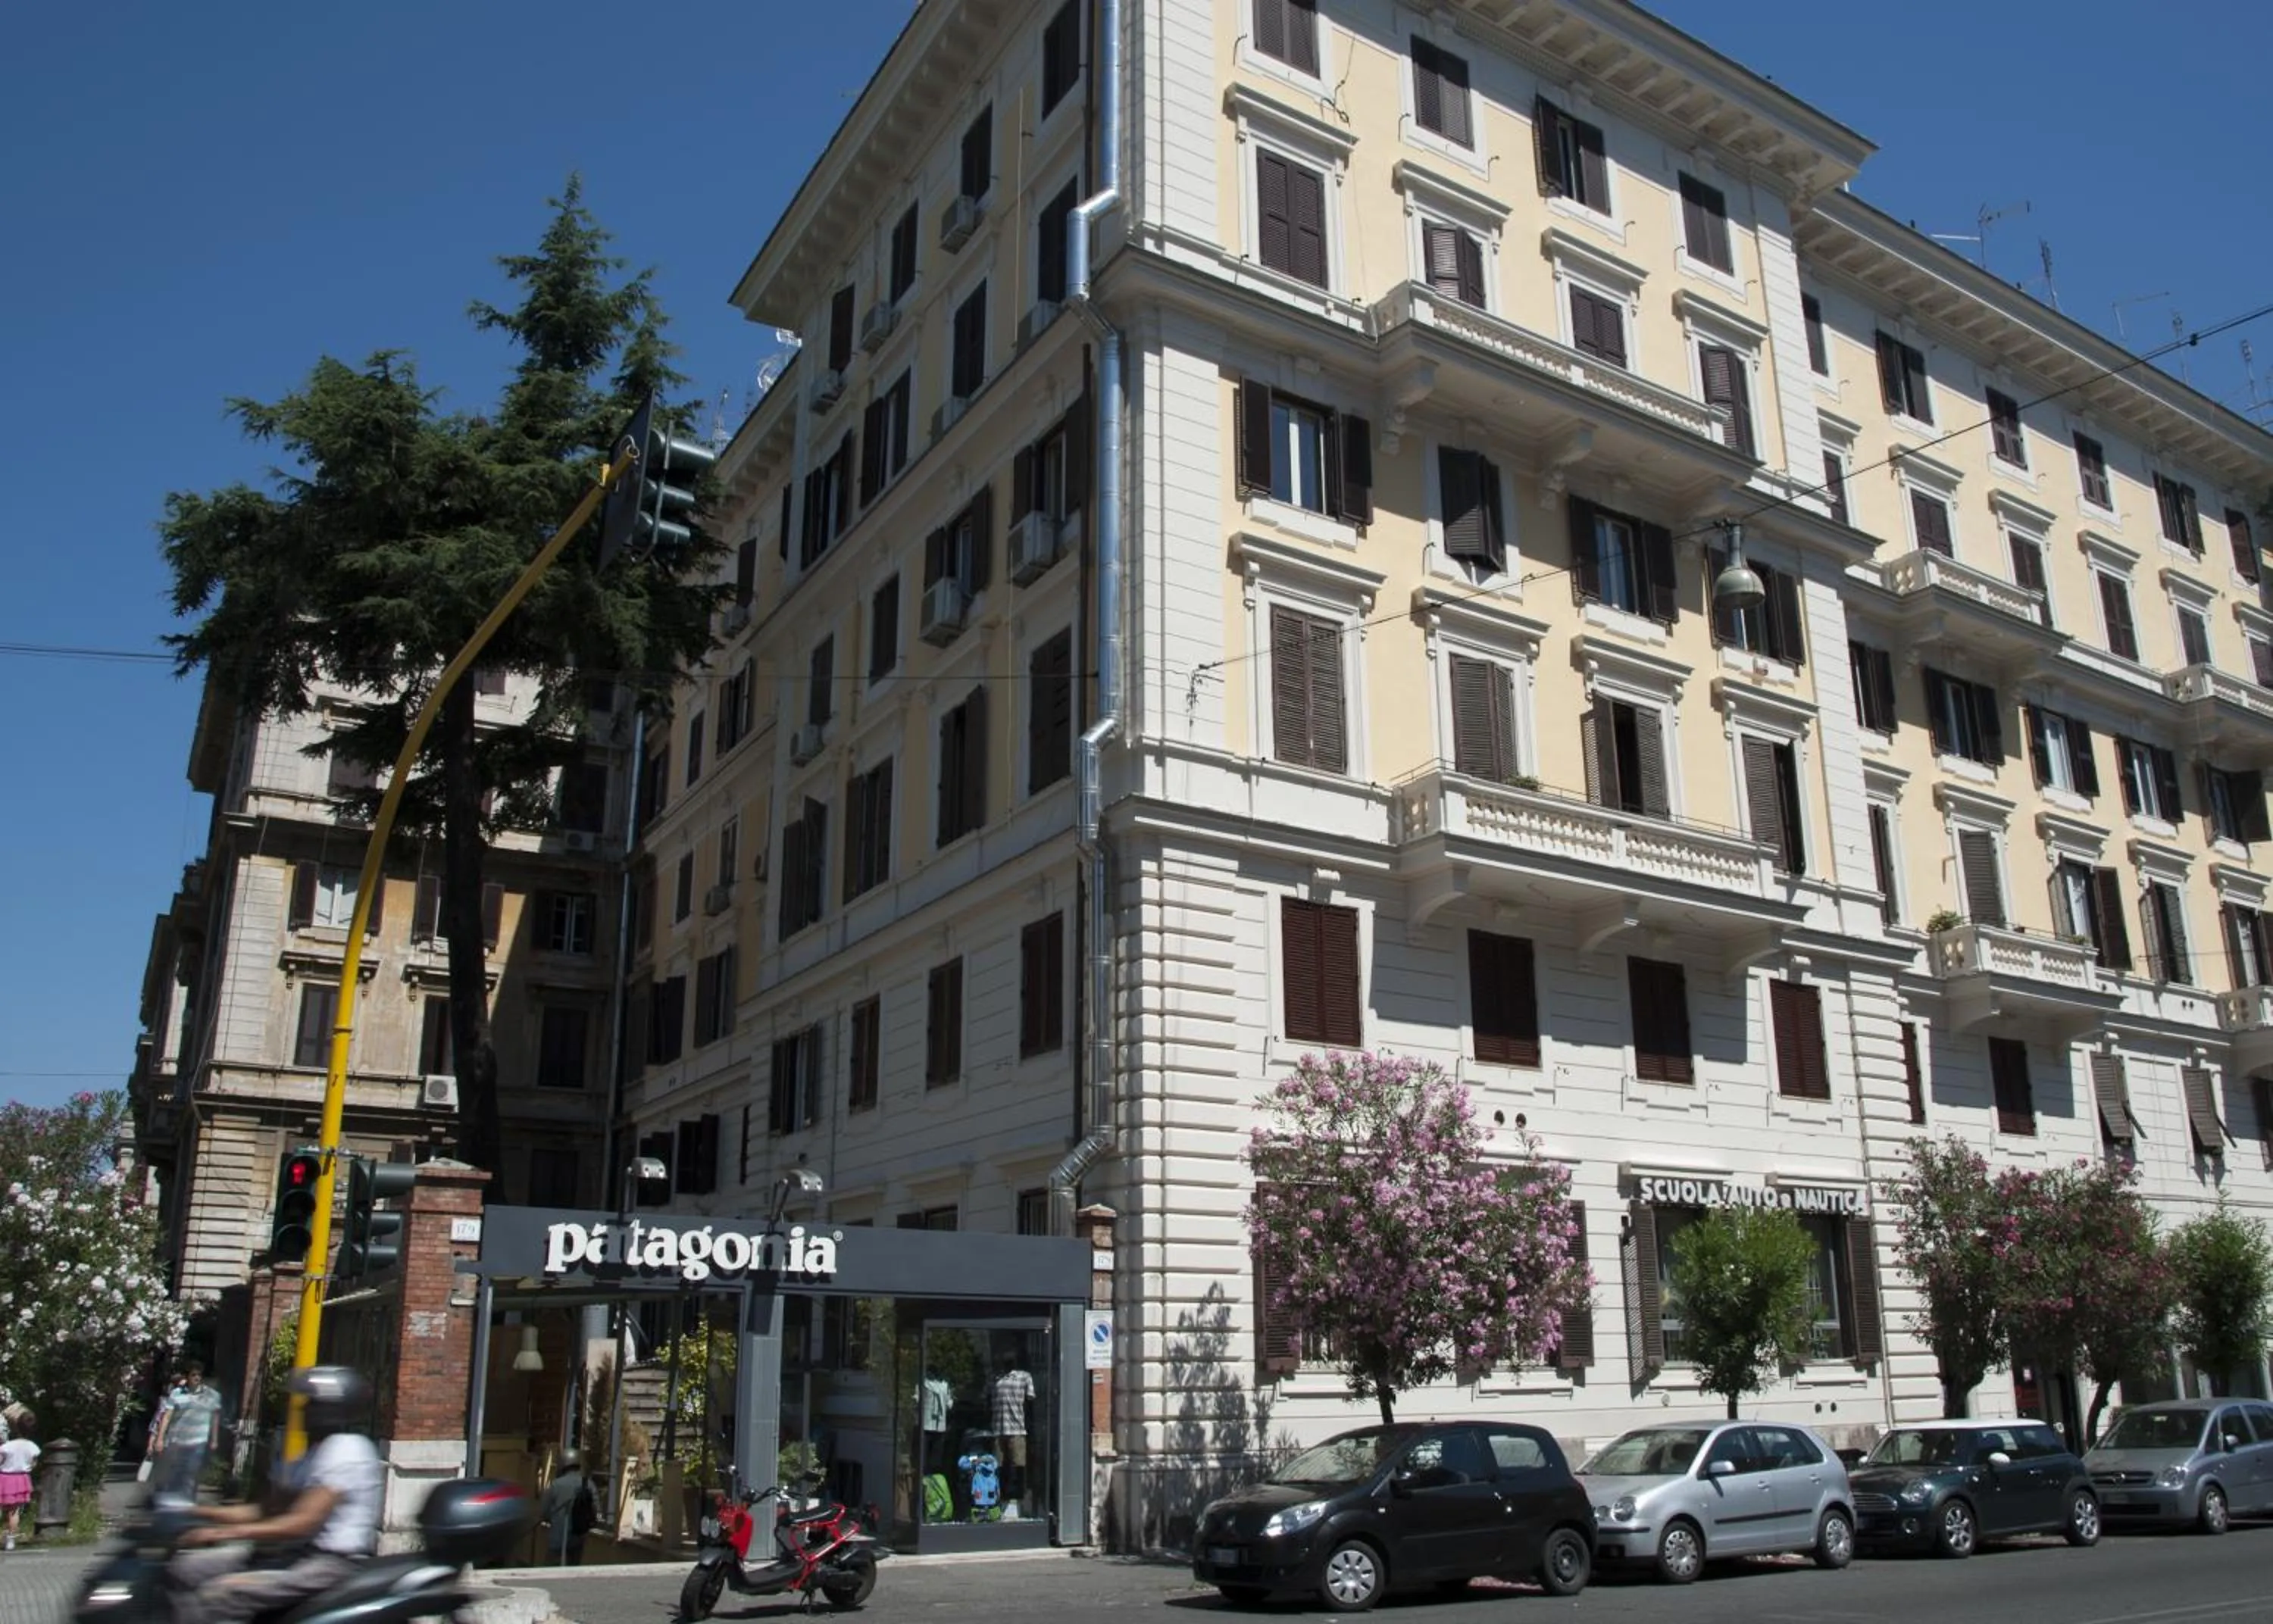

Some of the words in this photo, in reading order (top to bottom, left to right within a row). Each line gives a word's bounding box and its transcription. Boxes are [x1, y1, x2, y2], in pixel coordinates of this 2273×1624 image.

[1640, 1177, 1721, 1204] SCUOLA
[1727, 1184, 1778, 1207] AUTO
[1794, 1188, 1867, 1213] NAUTICA
[544, 1219, 837, 1281] patagonia
